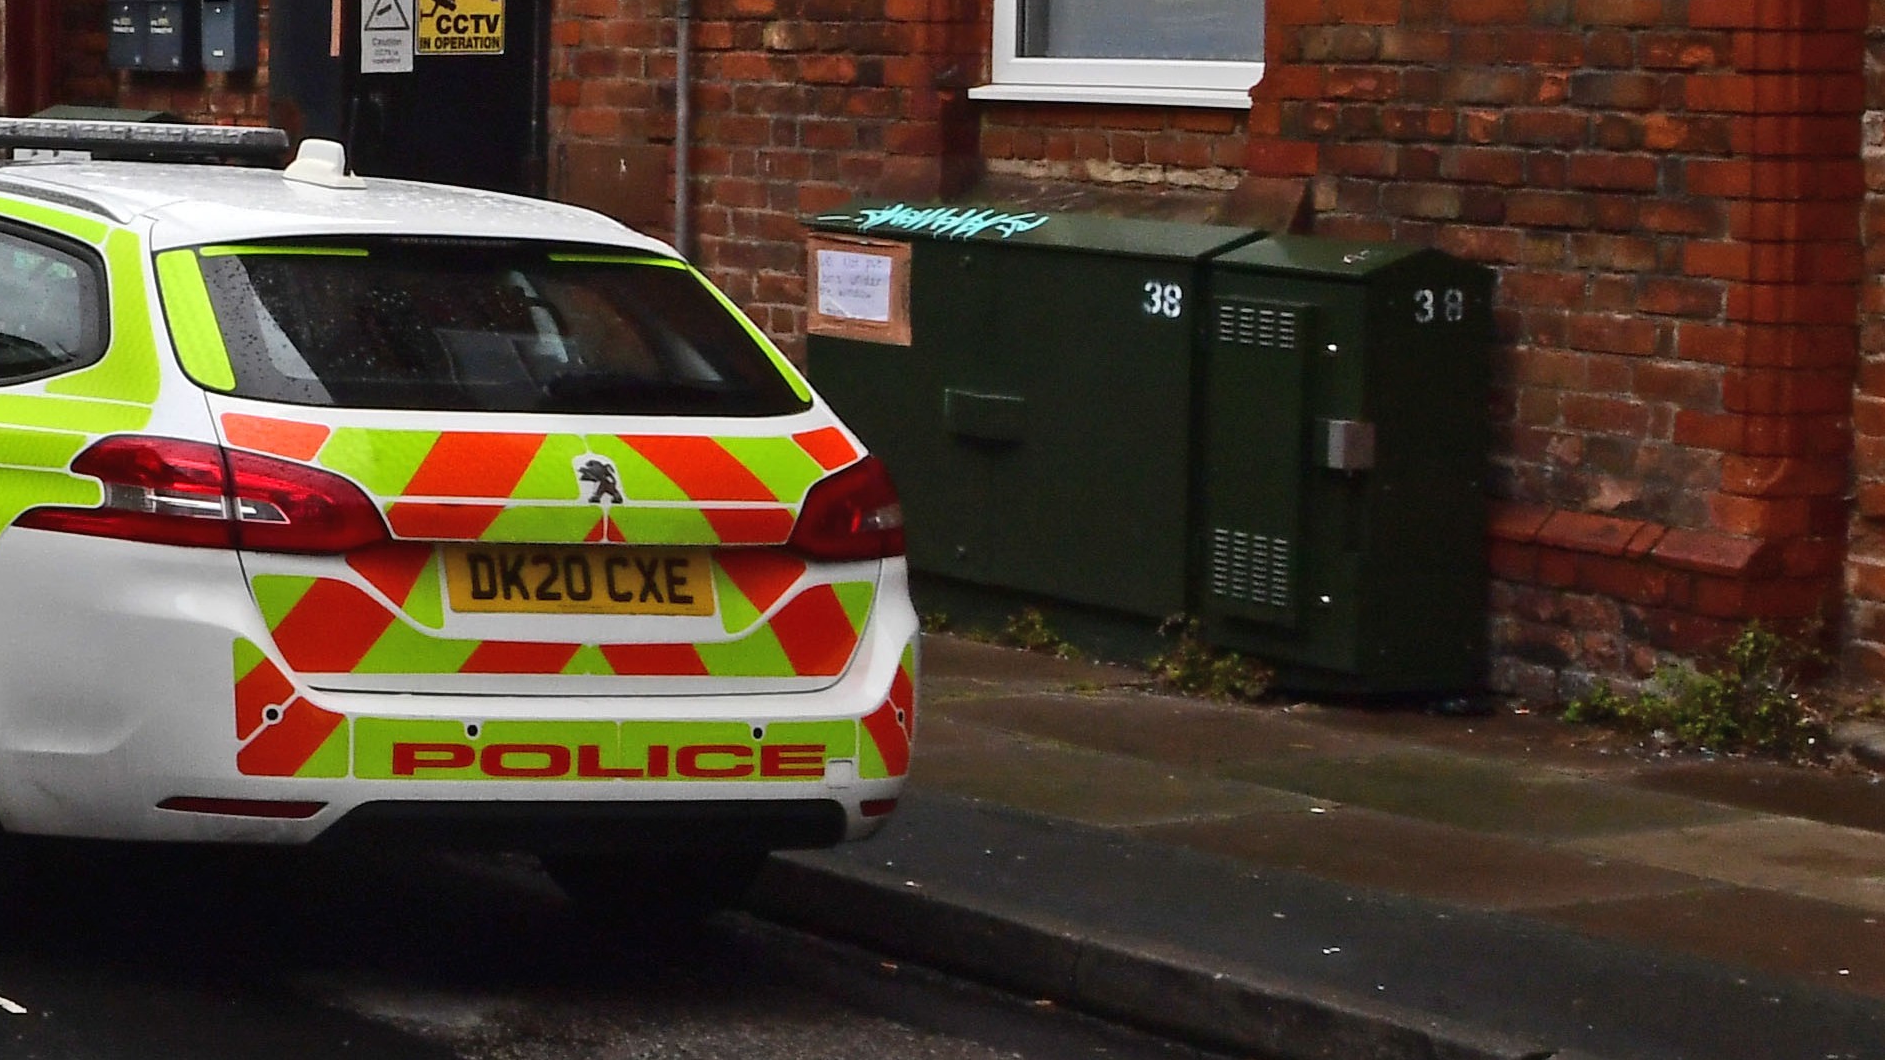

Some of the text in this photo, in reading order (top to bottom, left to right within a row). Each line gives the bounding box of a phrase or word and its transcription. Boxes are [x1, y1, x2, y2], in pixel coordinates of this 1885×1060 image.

[436, 14, 500, 34] CCTV
[419, 36, 500, 49] IN OPERATION
[1144, 281, 1182, 318] 38
[468, 552, 694, 604] DK20 CXE
[392, 742, 826, 778] POLICE
